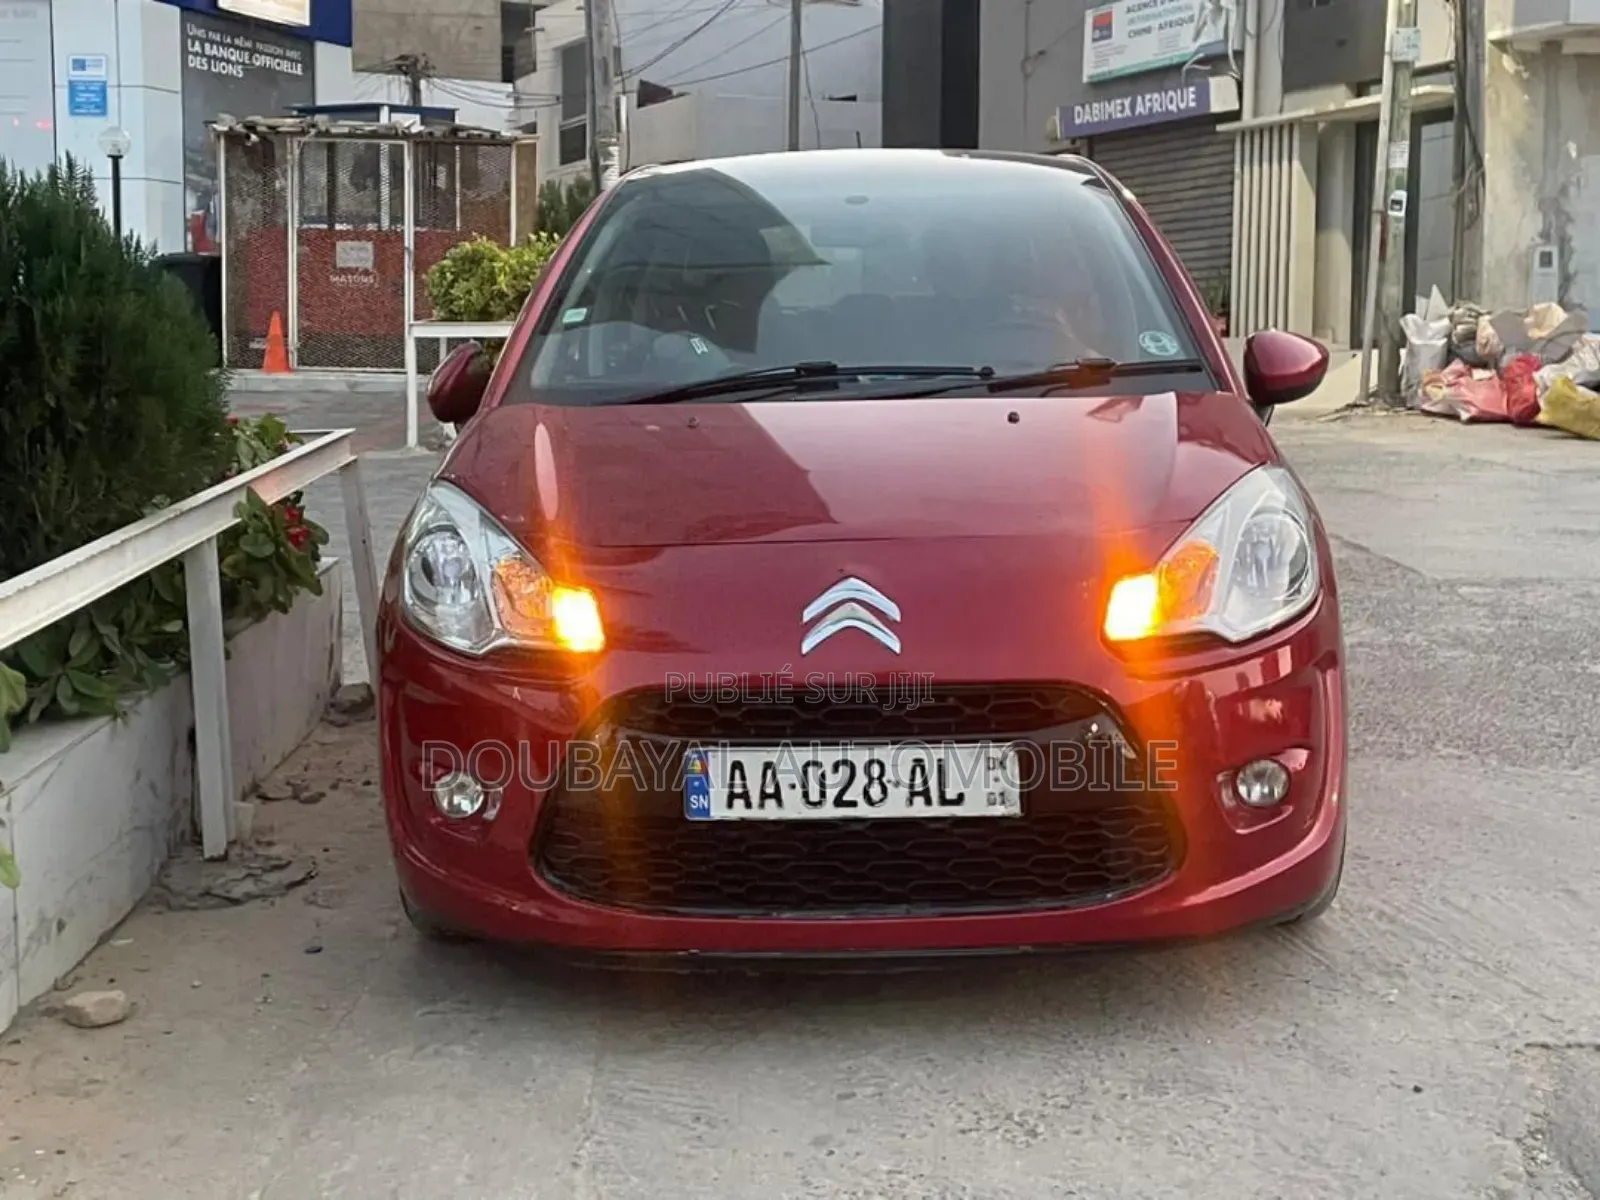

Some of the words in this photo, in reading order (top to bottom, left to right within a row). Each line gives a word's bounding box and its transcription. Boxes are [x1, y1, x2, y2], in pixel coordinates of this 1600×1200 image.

[223, 33, 232, 44] LA
[187, 38, 202, 54] LA
[204, 41, 250, 64] BANQUE
[252, 53, 304, 76] OFFICIELLE
[187, 54, 208, 71] DES
[210, 58, 244, 78] LIONS
[1073, 96, 1133, 126] DABIMEX
[1134, 86, 1198, 117] AFRIQUE
[689, 794, 709, 810] SN
